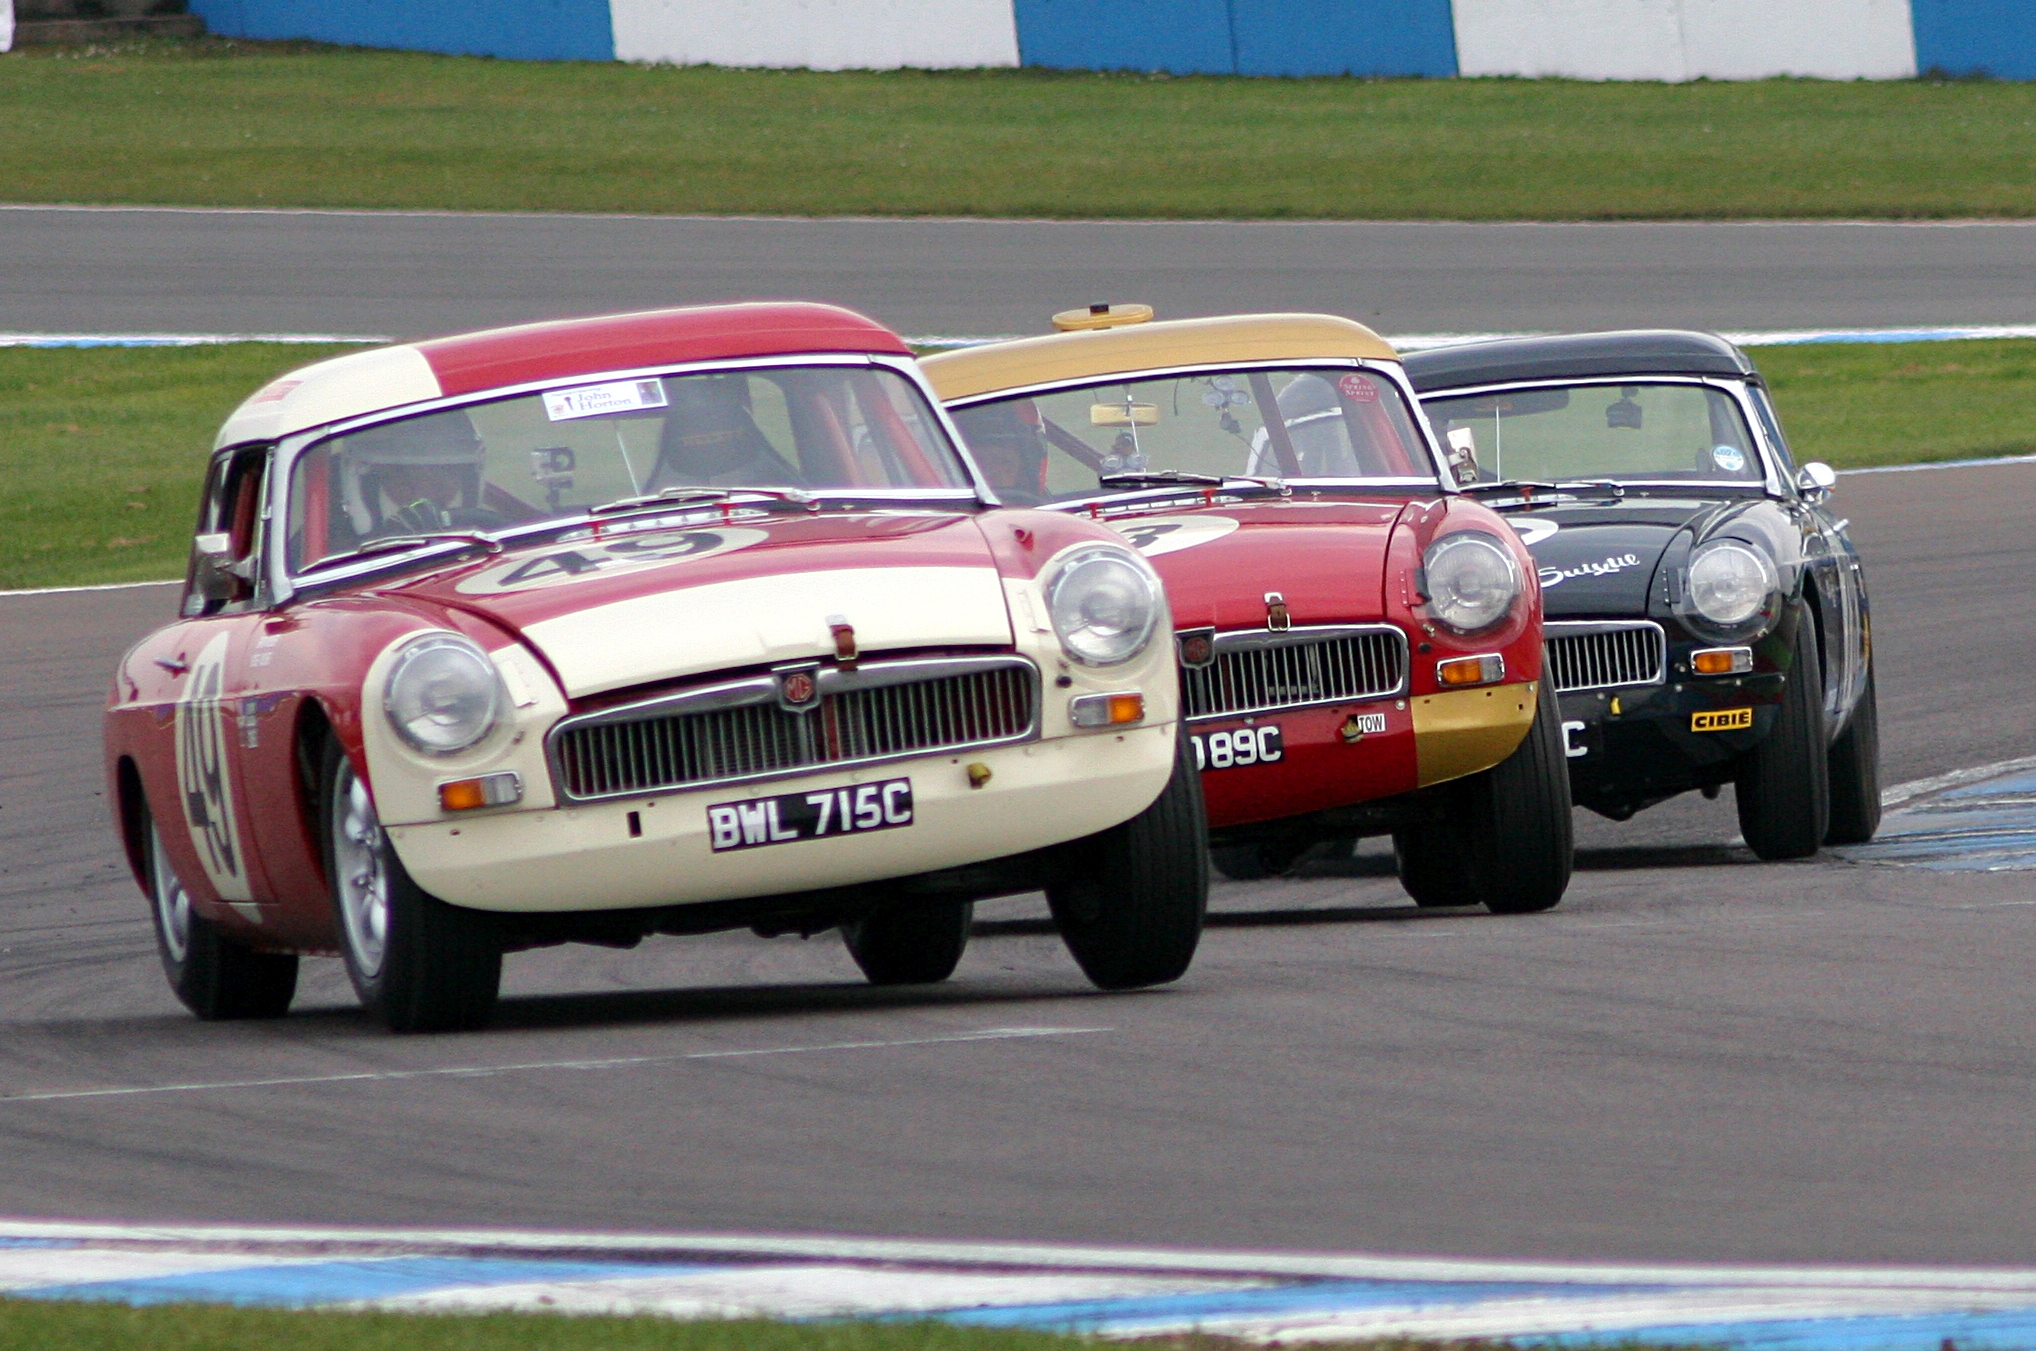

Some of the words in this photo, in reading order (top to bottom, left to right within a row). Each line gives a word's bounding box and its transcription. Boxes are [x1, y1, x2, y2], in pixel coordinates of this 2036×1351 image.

[578, 392, 611, 402] John
[580, 398, 632, 411] Horton
[498, 532, 724, 585] 49
[1359, 715, 1383, 732] TOW
[1695, 712, 1750, 728] CIBIE
[709, 800, 799, 849] BWL
[806, 782, 912, 836] 715C
